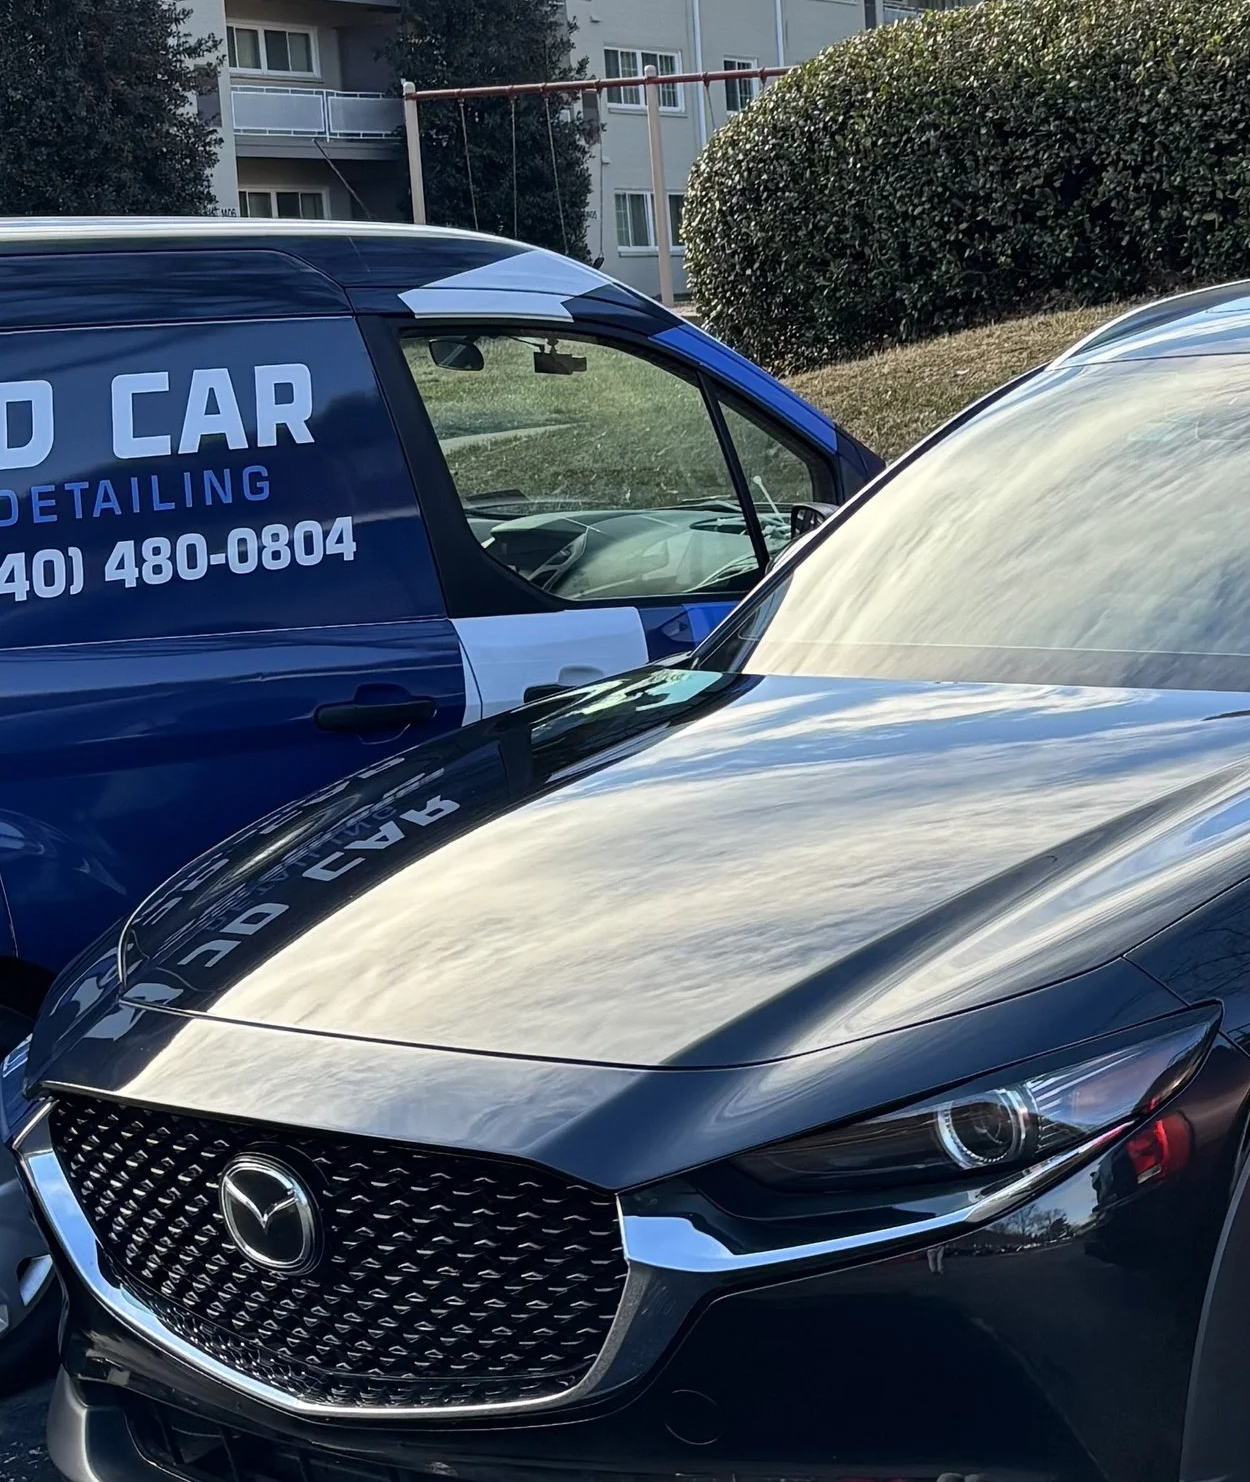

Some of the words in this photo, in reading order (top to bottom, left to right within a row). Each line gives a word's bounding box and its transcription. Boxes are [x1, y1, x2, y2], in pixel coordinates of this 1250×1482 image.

[0, 380, 54, 470] D
[111, 363, 315, 459] CAR
[0, 465, 270, 527] DETAILING
[0, 546, 84, 601] 40)
[104, 516, 356, 588] 480-0804
